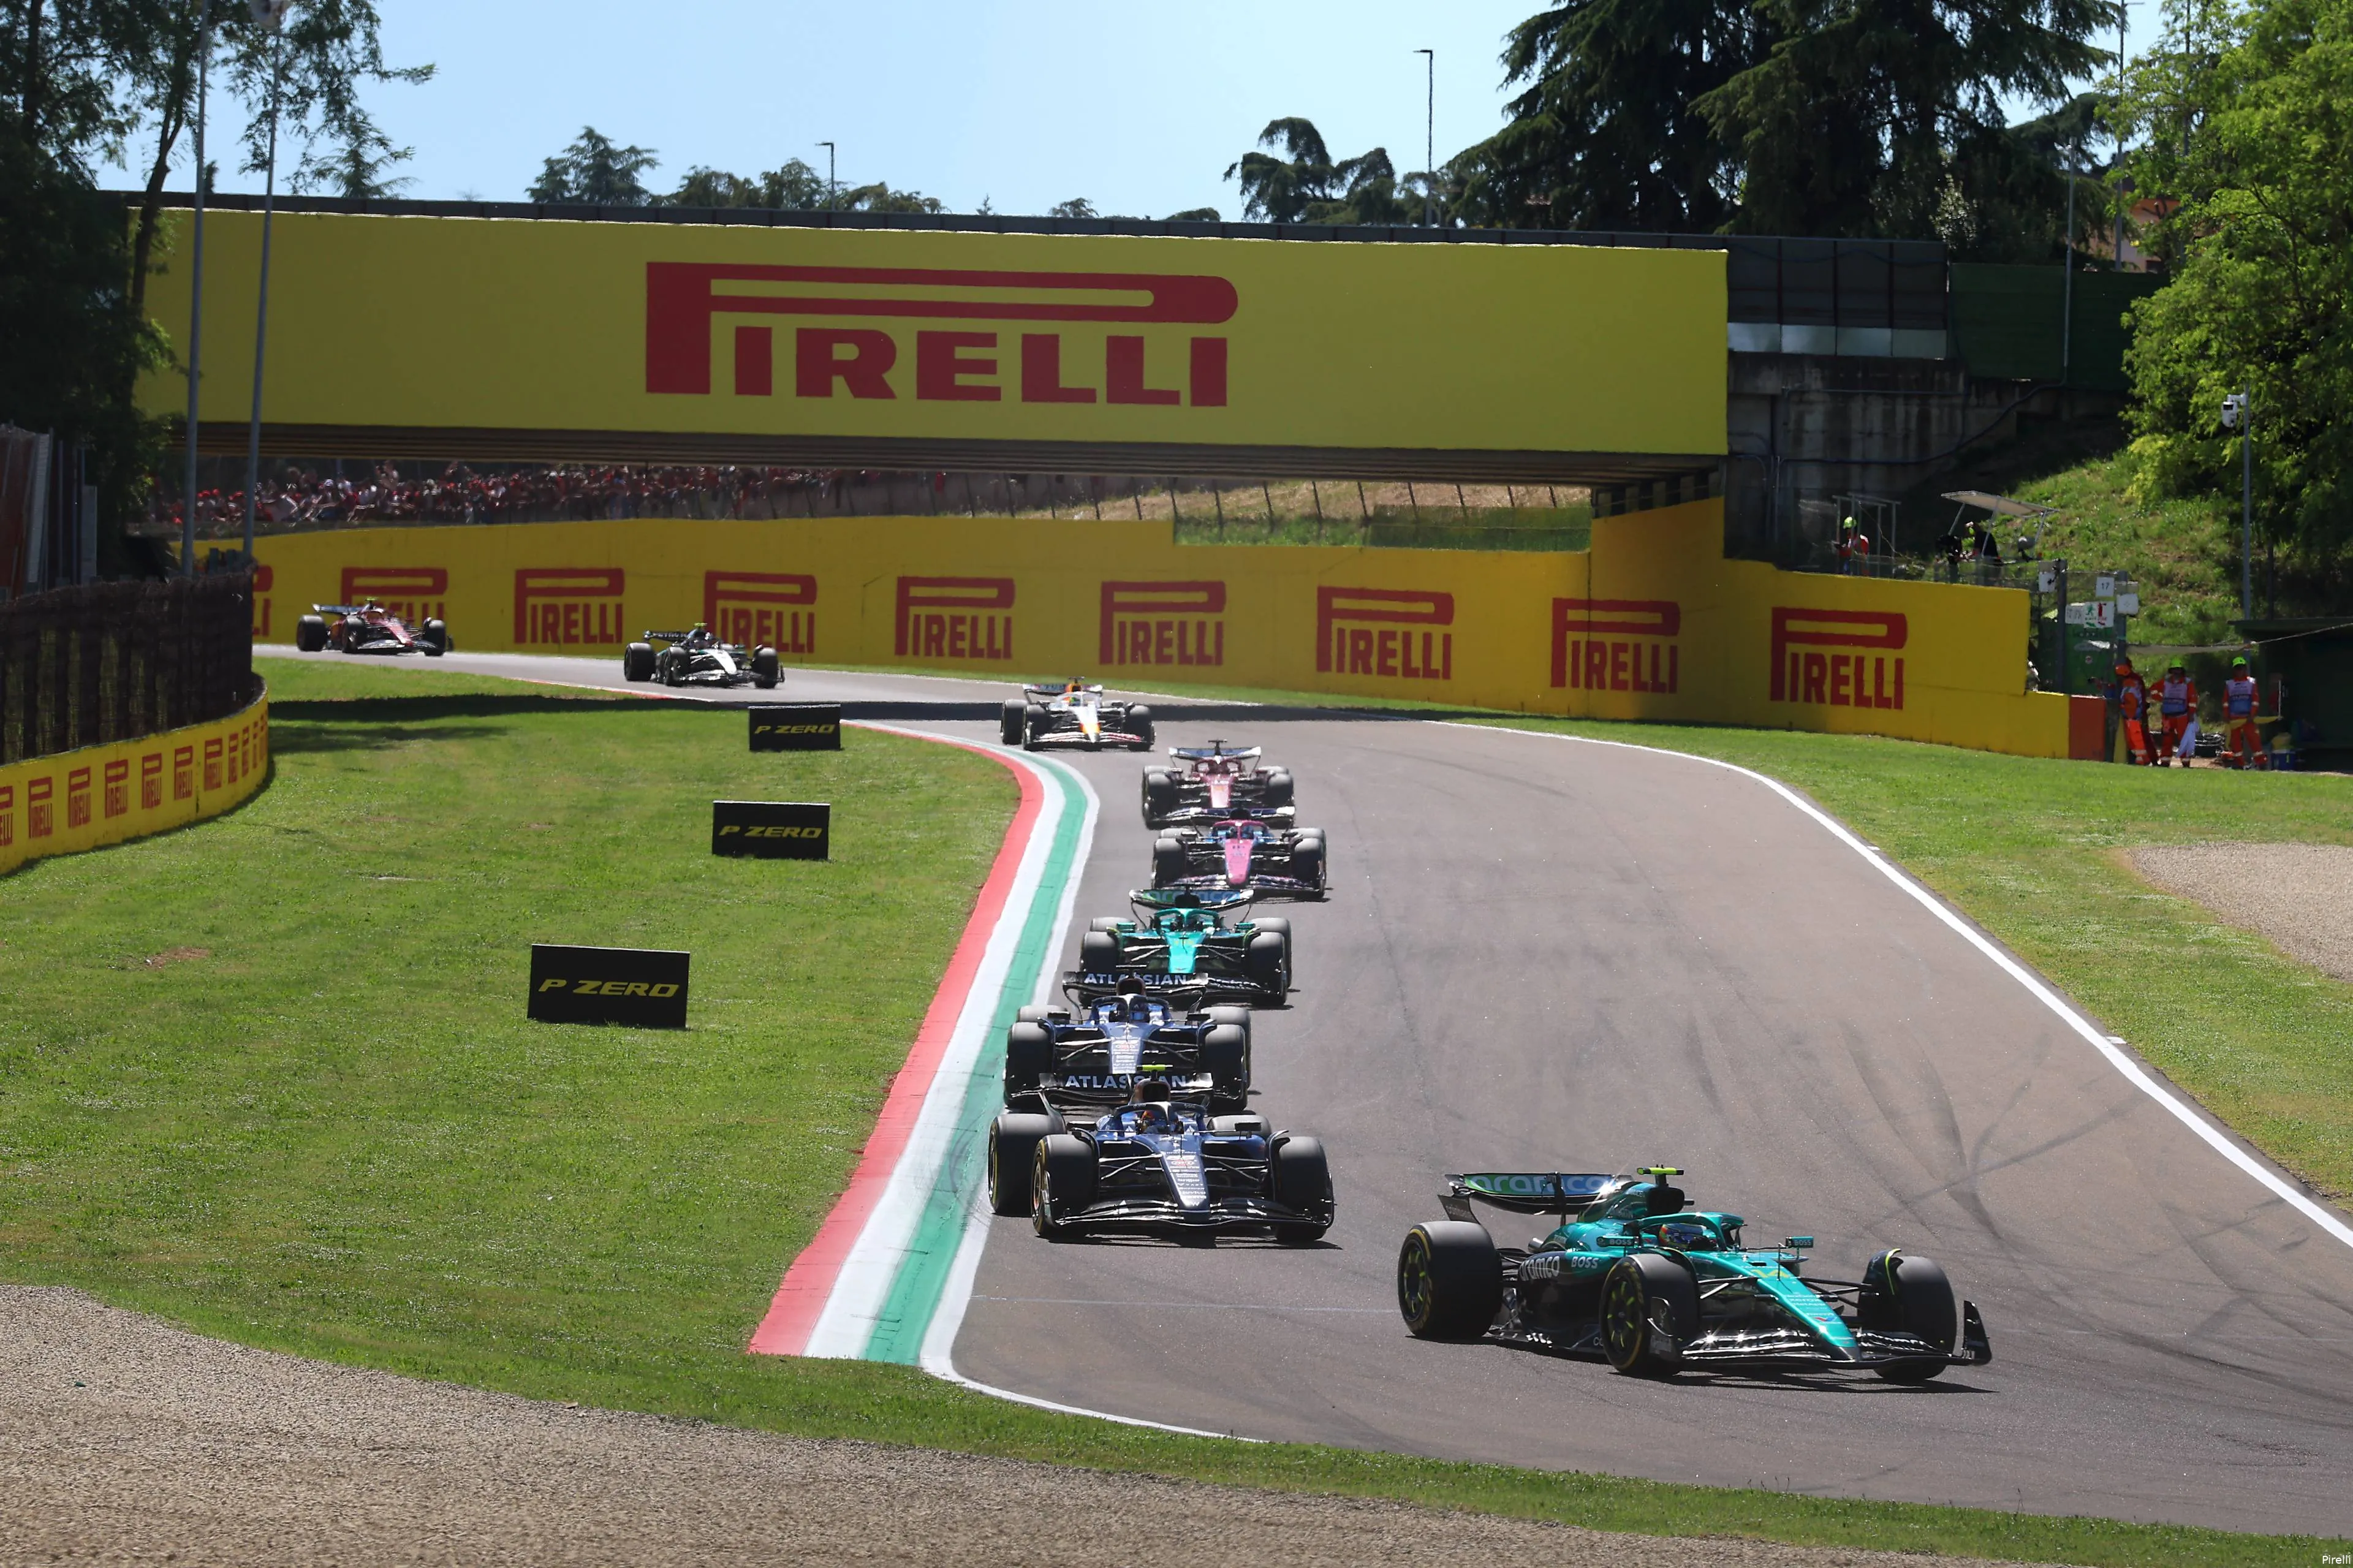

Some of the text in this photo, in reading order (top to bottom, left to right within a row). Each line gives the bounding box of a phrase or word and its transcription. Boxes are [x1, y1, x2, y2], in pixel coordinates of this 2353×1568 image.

[646, 261, 1238, 406] PIRELLI
[514, 567, 624, 643] PIRELLI
[703, 570, 817, 653] PIRELLI
[895, 577, 1016, 659] PIRELLI
[1099, 580, 1226, 665] PIRELLI
[1316, 586, 1454, 680] PIRELLI
[1551, 597, 1680, 694] PIRELLI
[1770, 607, 1908, 710] PIRELLI
[754, 724, 835, 734] P ZERO
[719, 826, 822, 838] P ZERO
[539, 979, 679, 998] P ZERO
[1065, 1075, 1187, 1088] ATLASSAN
[1520, 1256, 1560, 1281] aramco
[1571, 1256, 1599, 1269] BOSS
[1750, 1269, 1791, 1278] 14
